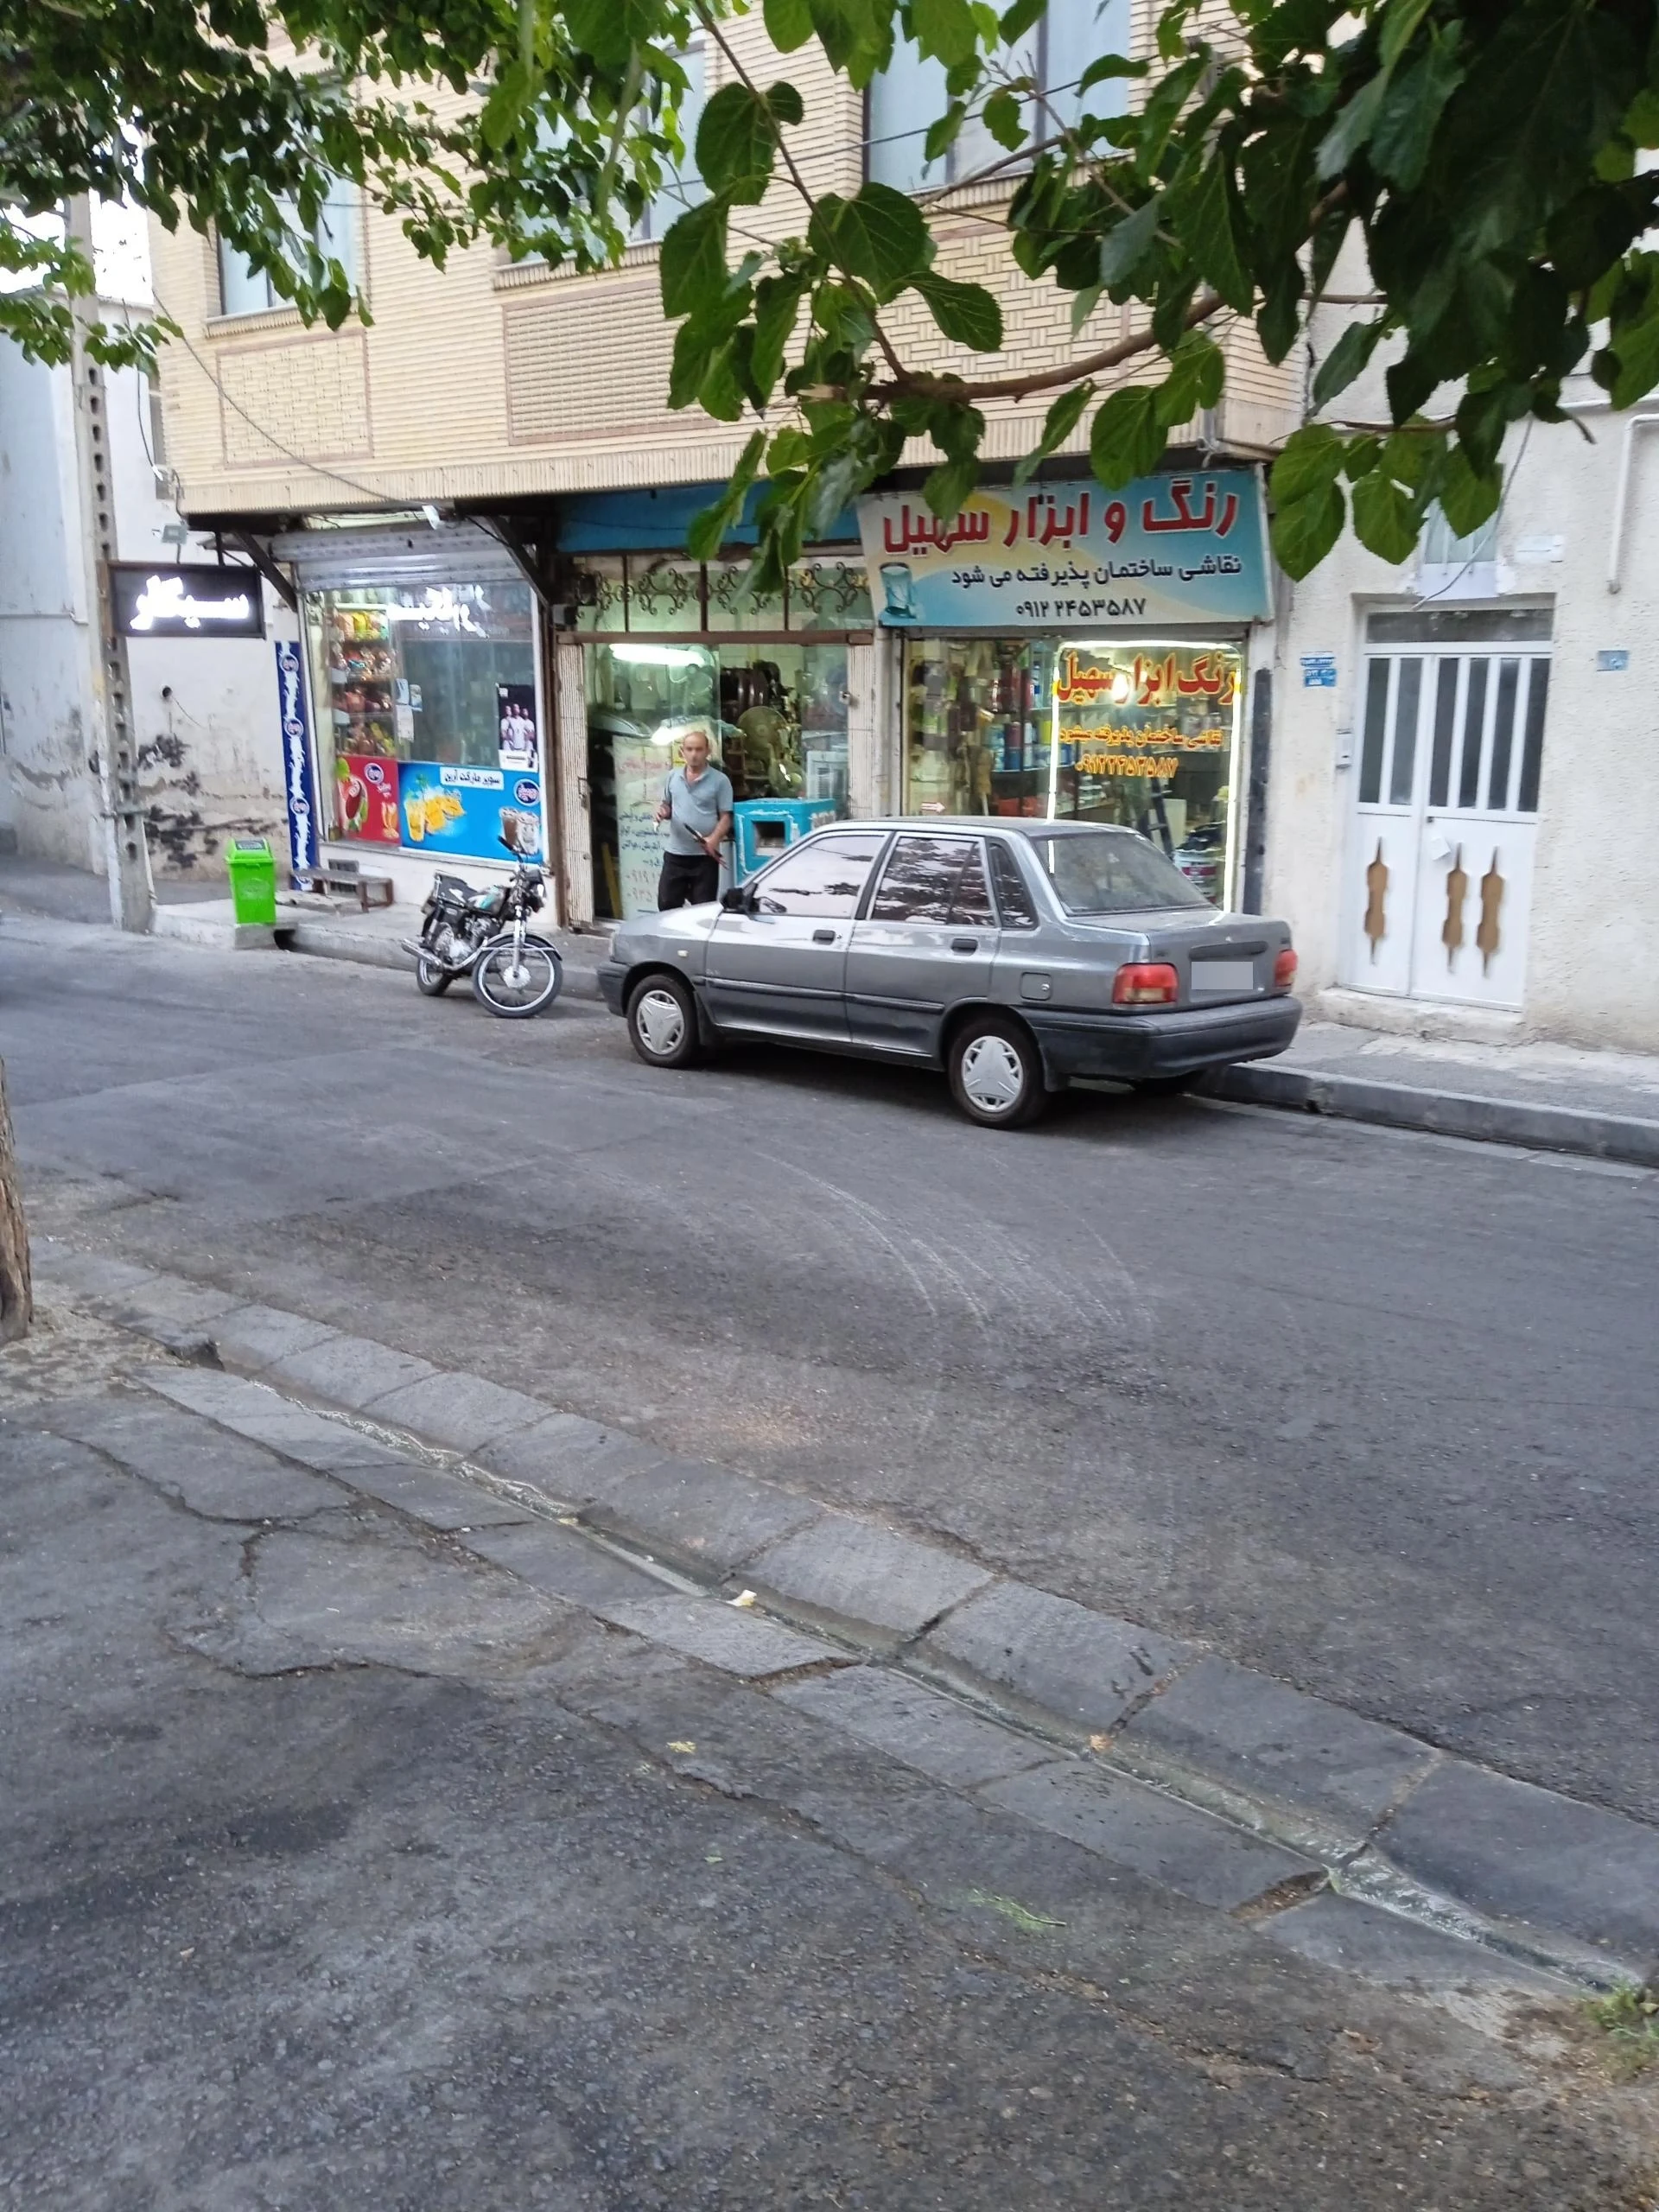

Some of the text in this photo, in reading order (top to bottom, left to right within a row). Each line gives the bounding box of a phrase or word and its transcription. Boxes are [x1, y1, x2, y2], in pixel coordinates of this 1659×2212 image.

[883, 478, 1238, 556] رنگ و ابزار سهیل
[951, 555, 1243, 589] نقاشی ساختمان پذیرفته می شود
[1176, 650, 1239, 706] رنگ
